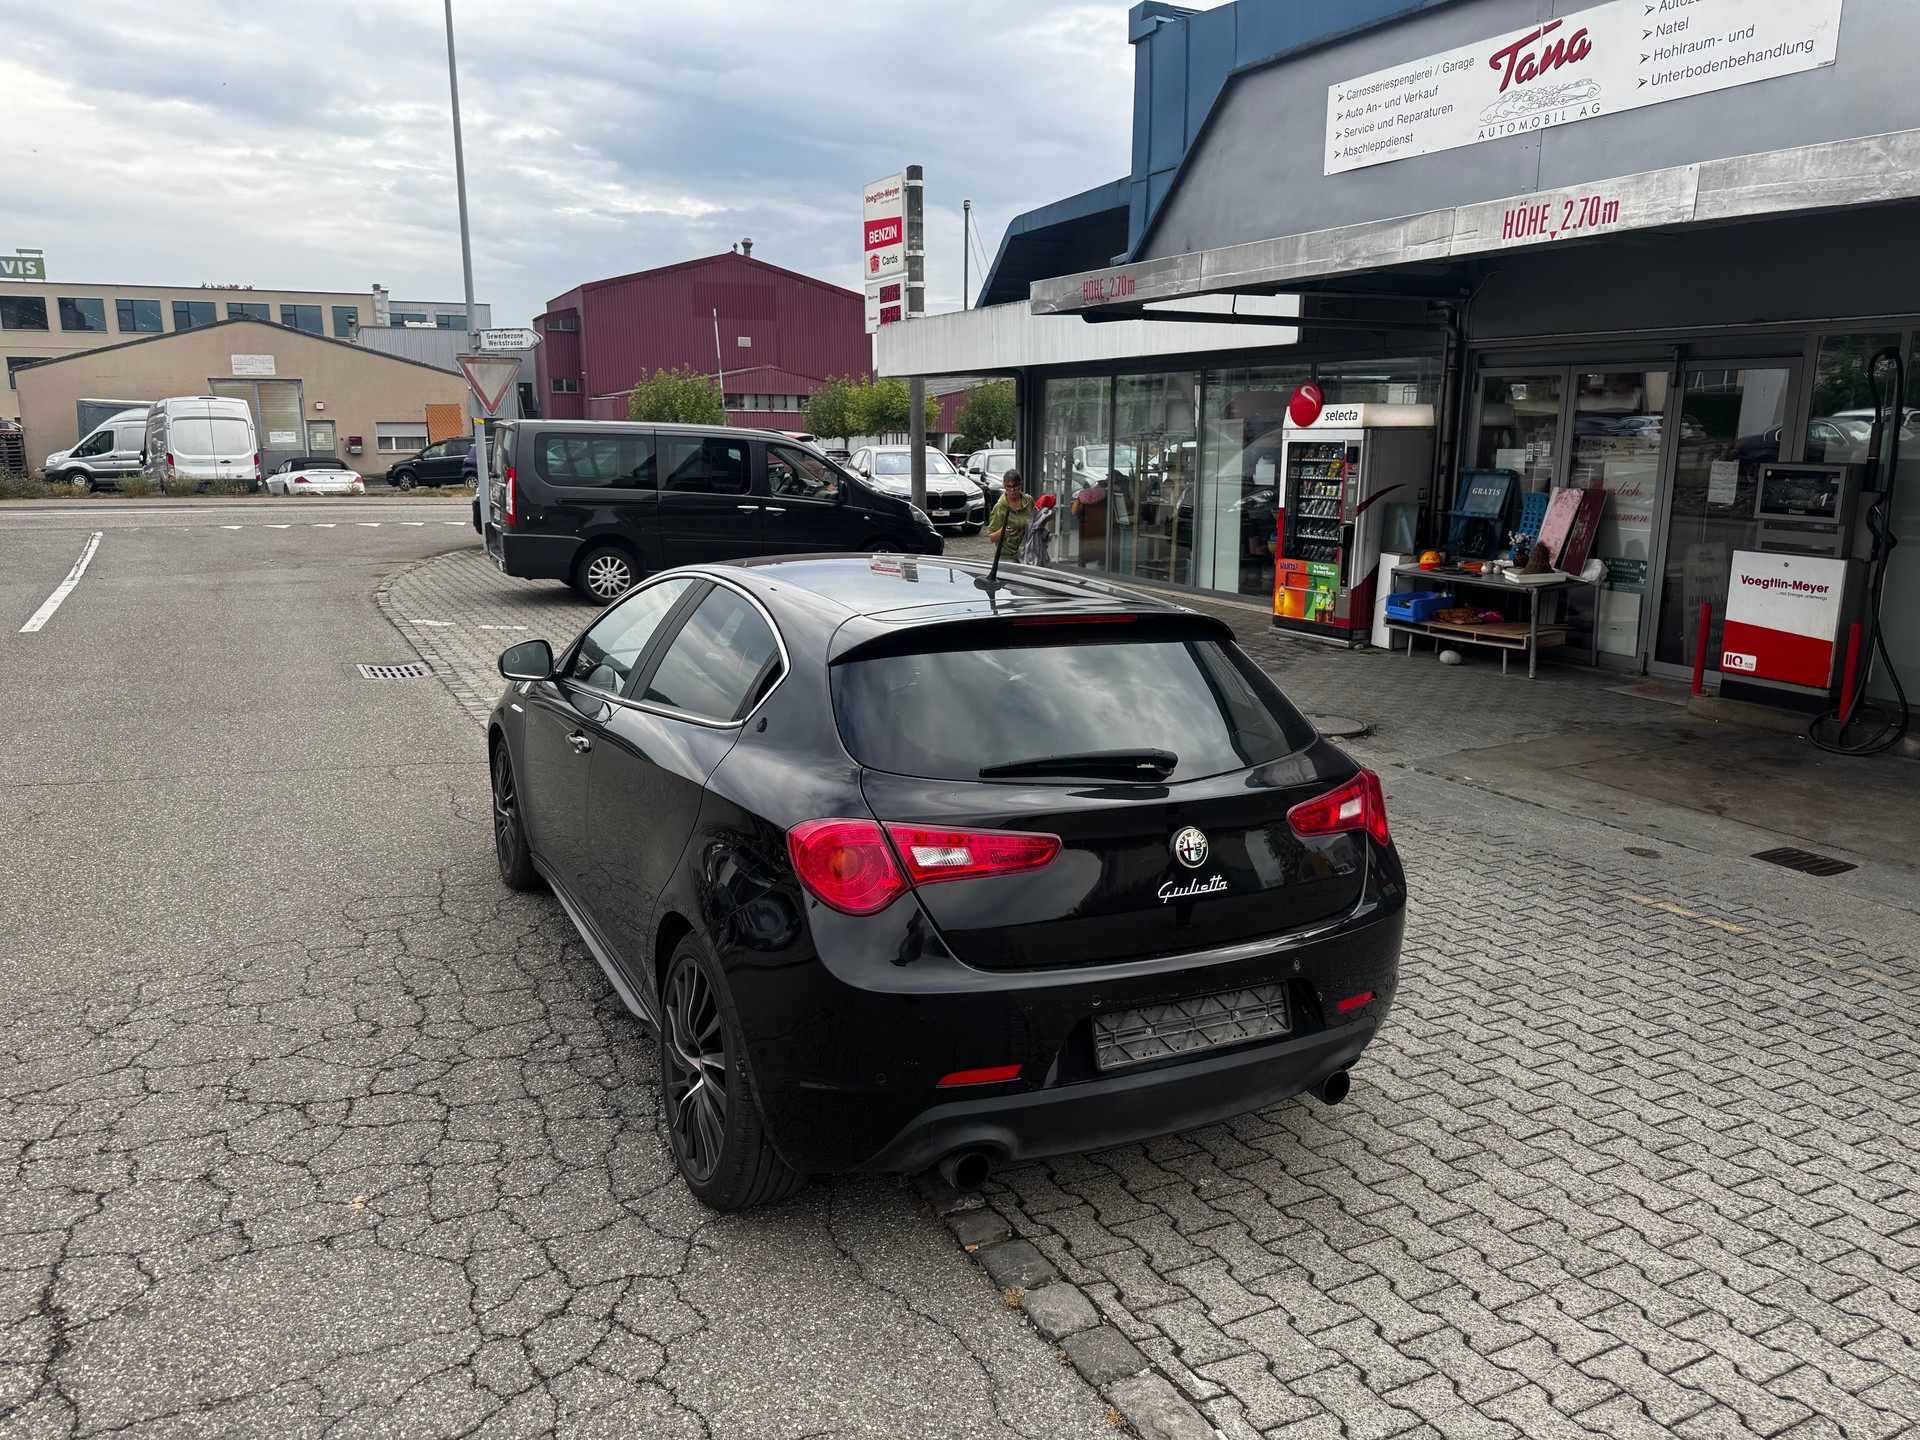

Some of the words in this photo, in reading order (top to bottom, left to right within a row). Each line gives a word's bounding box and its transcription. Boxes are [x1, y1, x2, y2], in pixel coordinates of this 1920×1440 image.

[1655, 16, 1690, 38] Natel
[1489, 19, 1592, 93] Tana
[1653, 37, 1723, 62] Hohlraum-
[1728, 24, 1755, 43] und
[1651, 40, 1814, 86] Unterbodenbehandlung
[1346, 66, 1433, 101] Carrosseriespenglerei
[1442, 57, 1475, 74] Garage
[1345, 108, 1364, 120] Auto
[1365, 103, 1382, 114] An-
[1384, 95, 1401, 109] und
[1404, 85, 1439, 103] Verkauf
[1344, 124, 1375, 139] Service
[1377, 114, 1394, 130] und
[1396, 104, 1454, 125] Reparaturen
[1477, 111, 1567, 140] AUTOMOBIL
[1579, 102, 1601, 117] AG
[1343, 132, 1414, 158] Abschleppdienst
[869, 225, 897, 244] BENZIN
[1502, 202, 1550, 240] HÖHE
[882, 254, 898, 266] Cards
[1083, 274, 1105, 302] HÖHE
[1324, 409, 1359, 421] selecta
[1472, 487, 1501, 496] GRATIS
[1741, 575, 1830, 594] Voegtlin-Meyer
[1157, 874, 1228, 904] Giulietta
